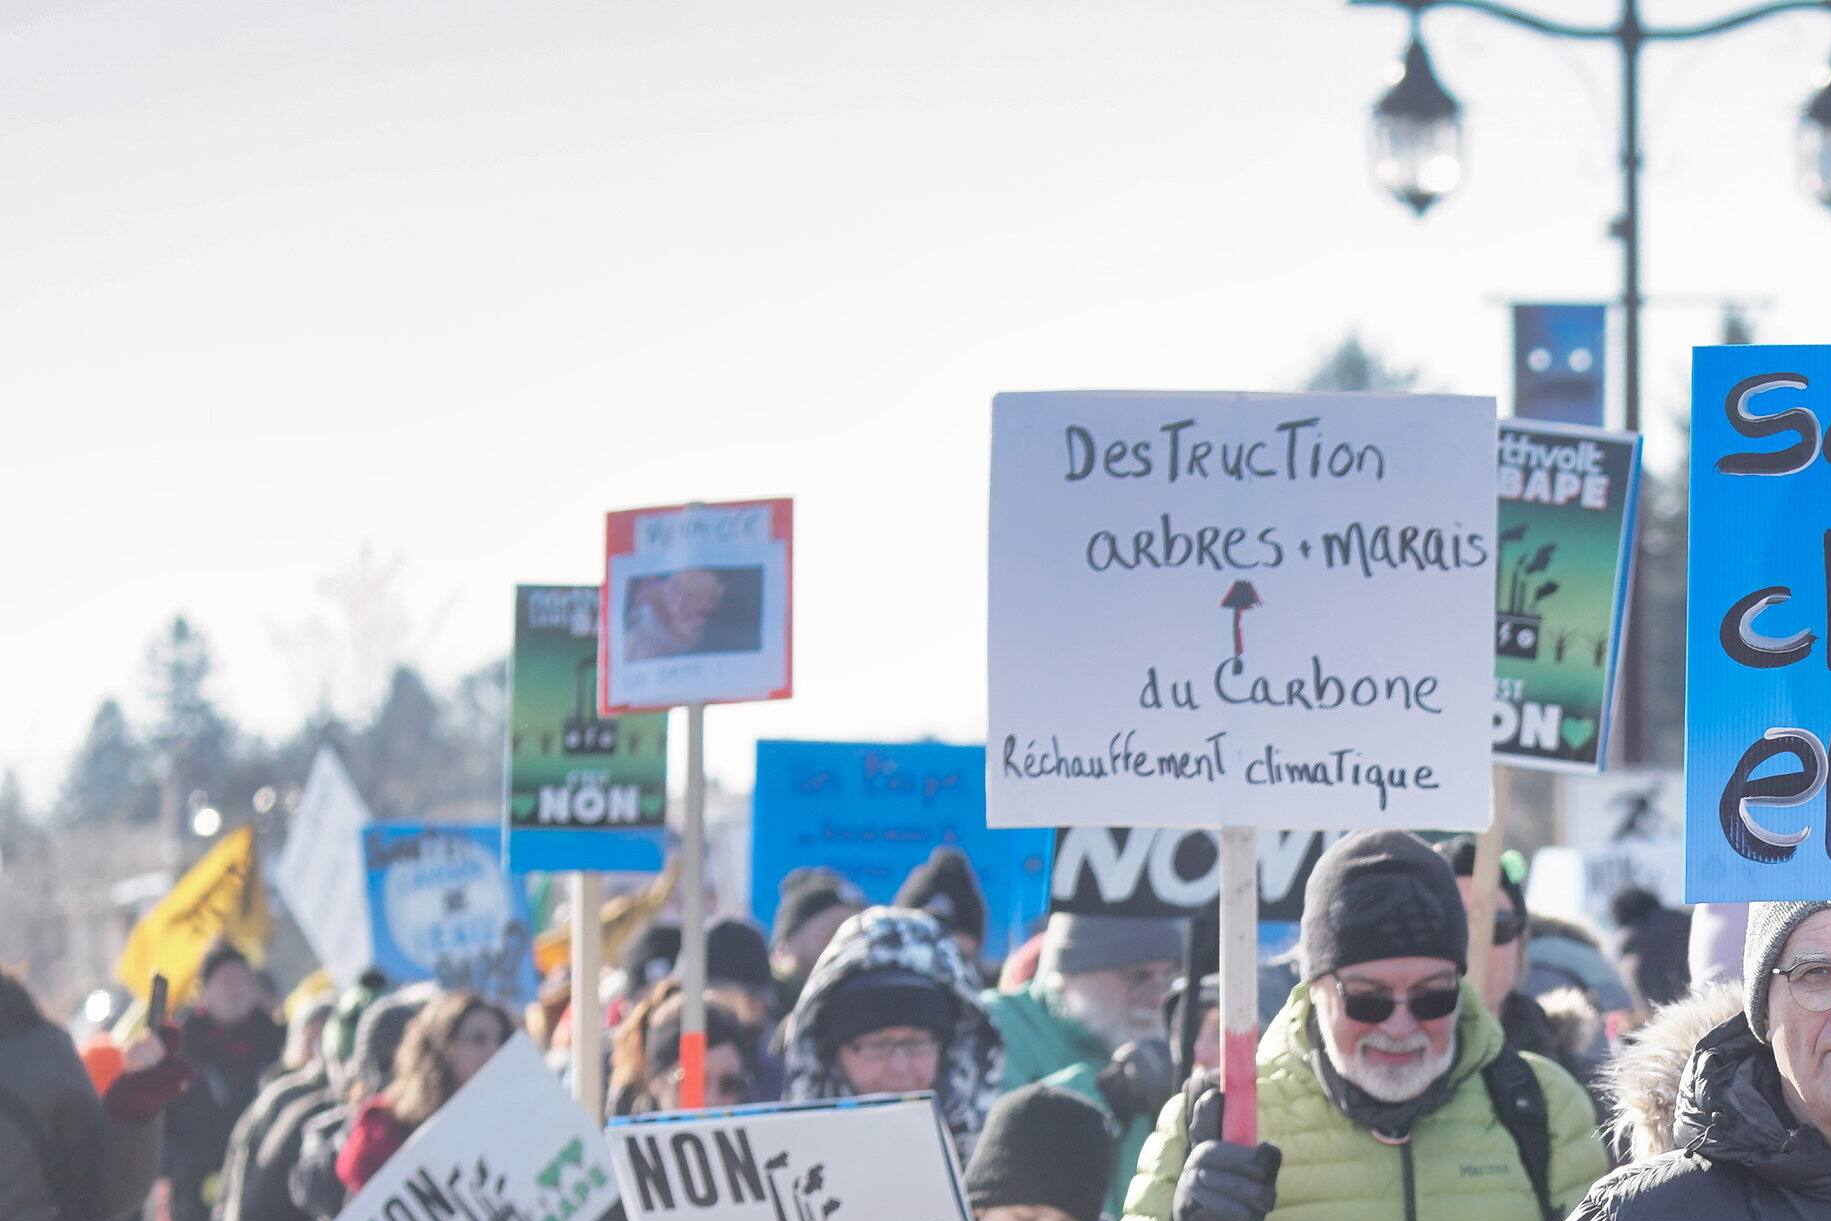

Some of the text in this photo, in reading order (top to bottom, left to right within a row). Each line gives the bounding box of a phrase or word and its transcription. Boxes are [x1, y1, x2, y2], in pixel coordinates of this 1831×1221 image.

[1497, 432, 1604, 474] thvolt
[1497, 466, 1609, 510] BAPE
[1139, 667, 1199, 711] du
[1488, 700, 1562, 752] ON
[538, 784, 640, 825] NON
[624, 1128, 766, 1212] NON
